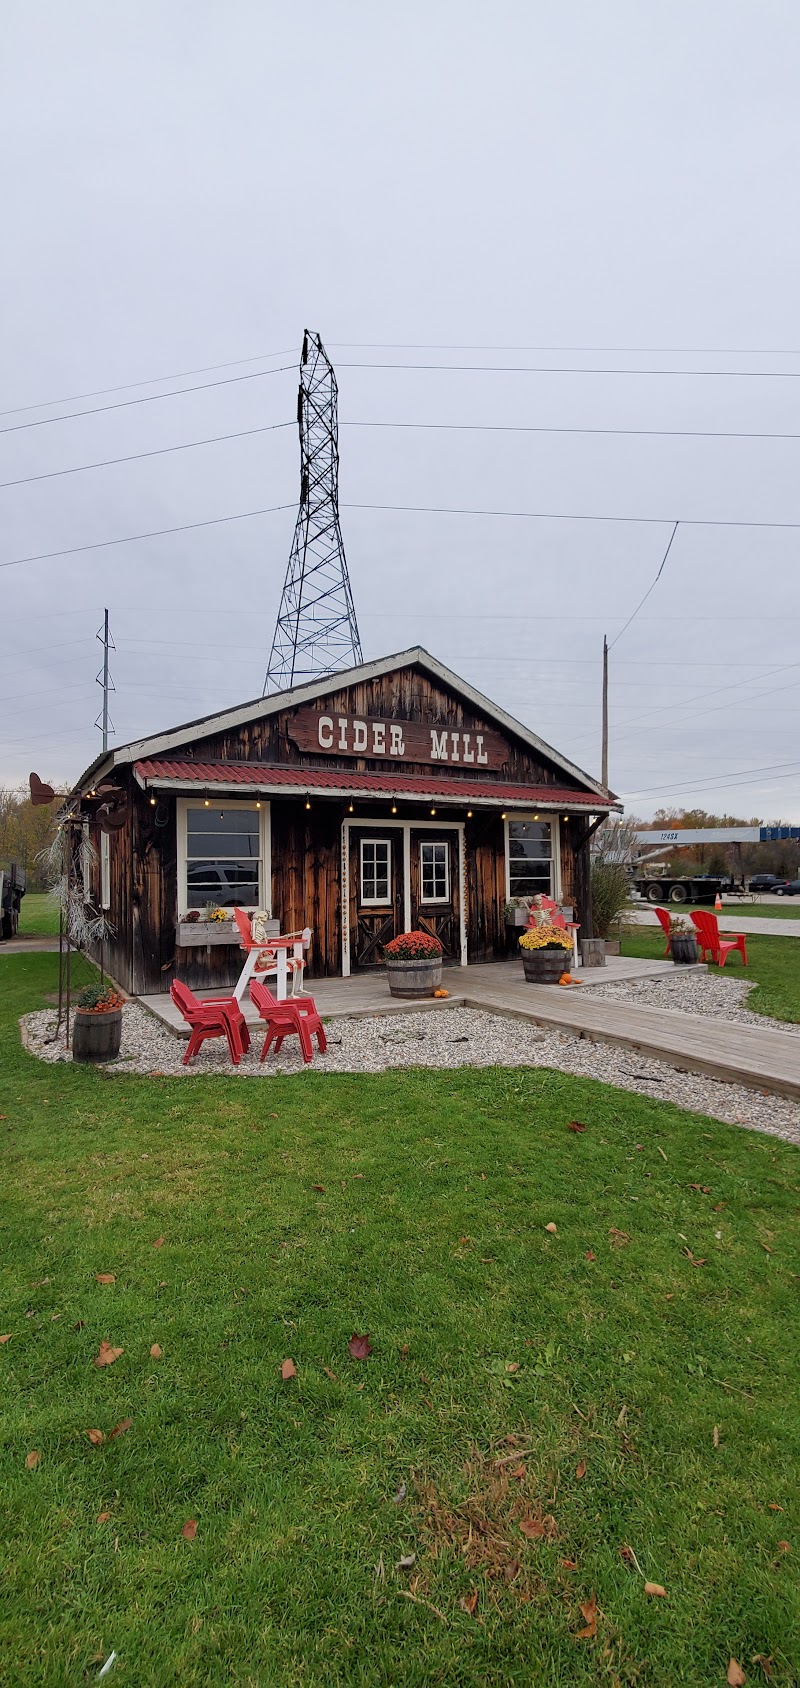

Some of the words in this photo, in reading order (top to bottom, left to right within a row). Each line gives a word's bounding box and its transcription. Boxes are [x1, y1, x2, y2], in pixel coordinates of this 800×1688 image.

[318, 716, 405, 756] CIDER
[430, 729, 488, 764] MILL
[660, 832, 679, 841] 124SX
